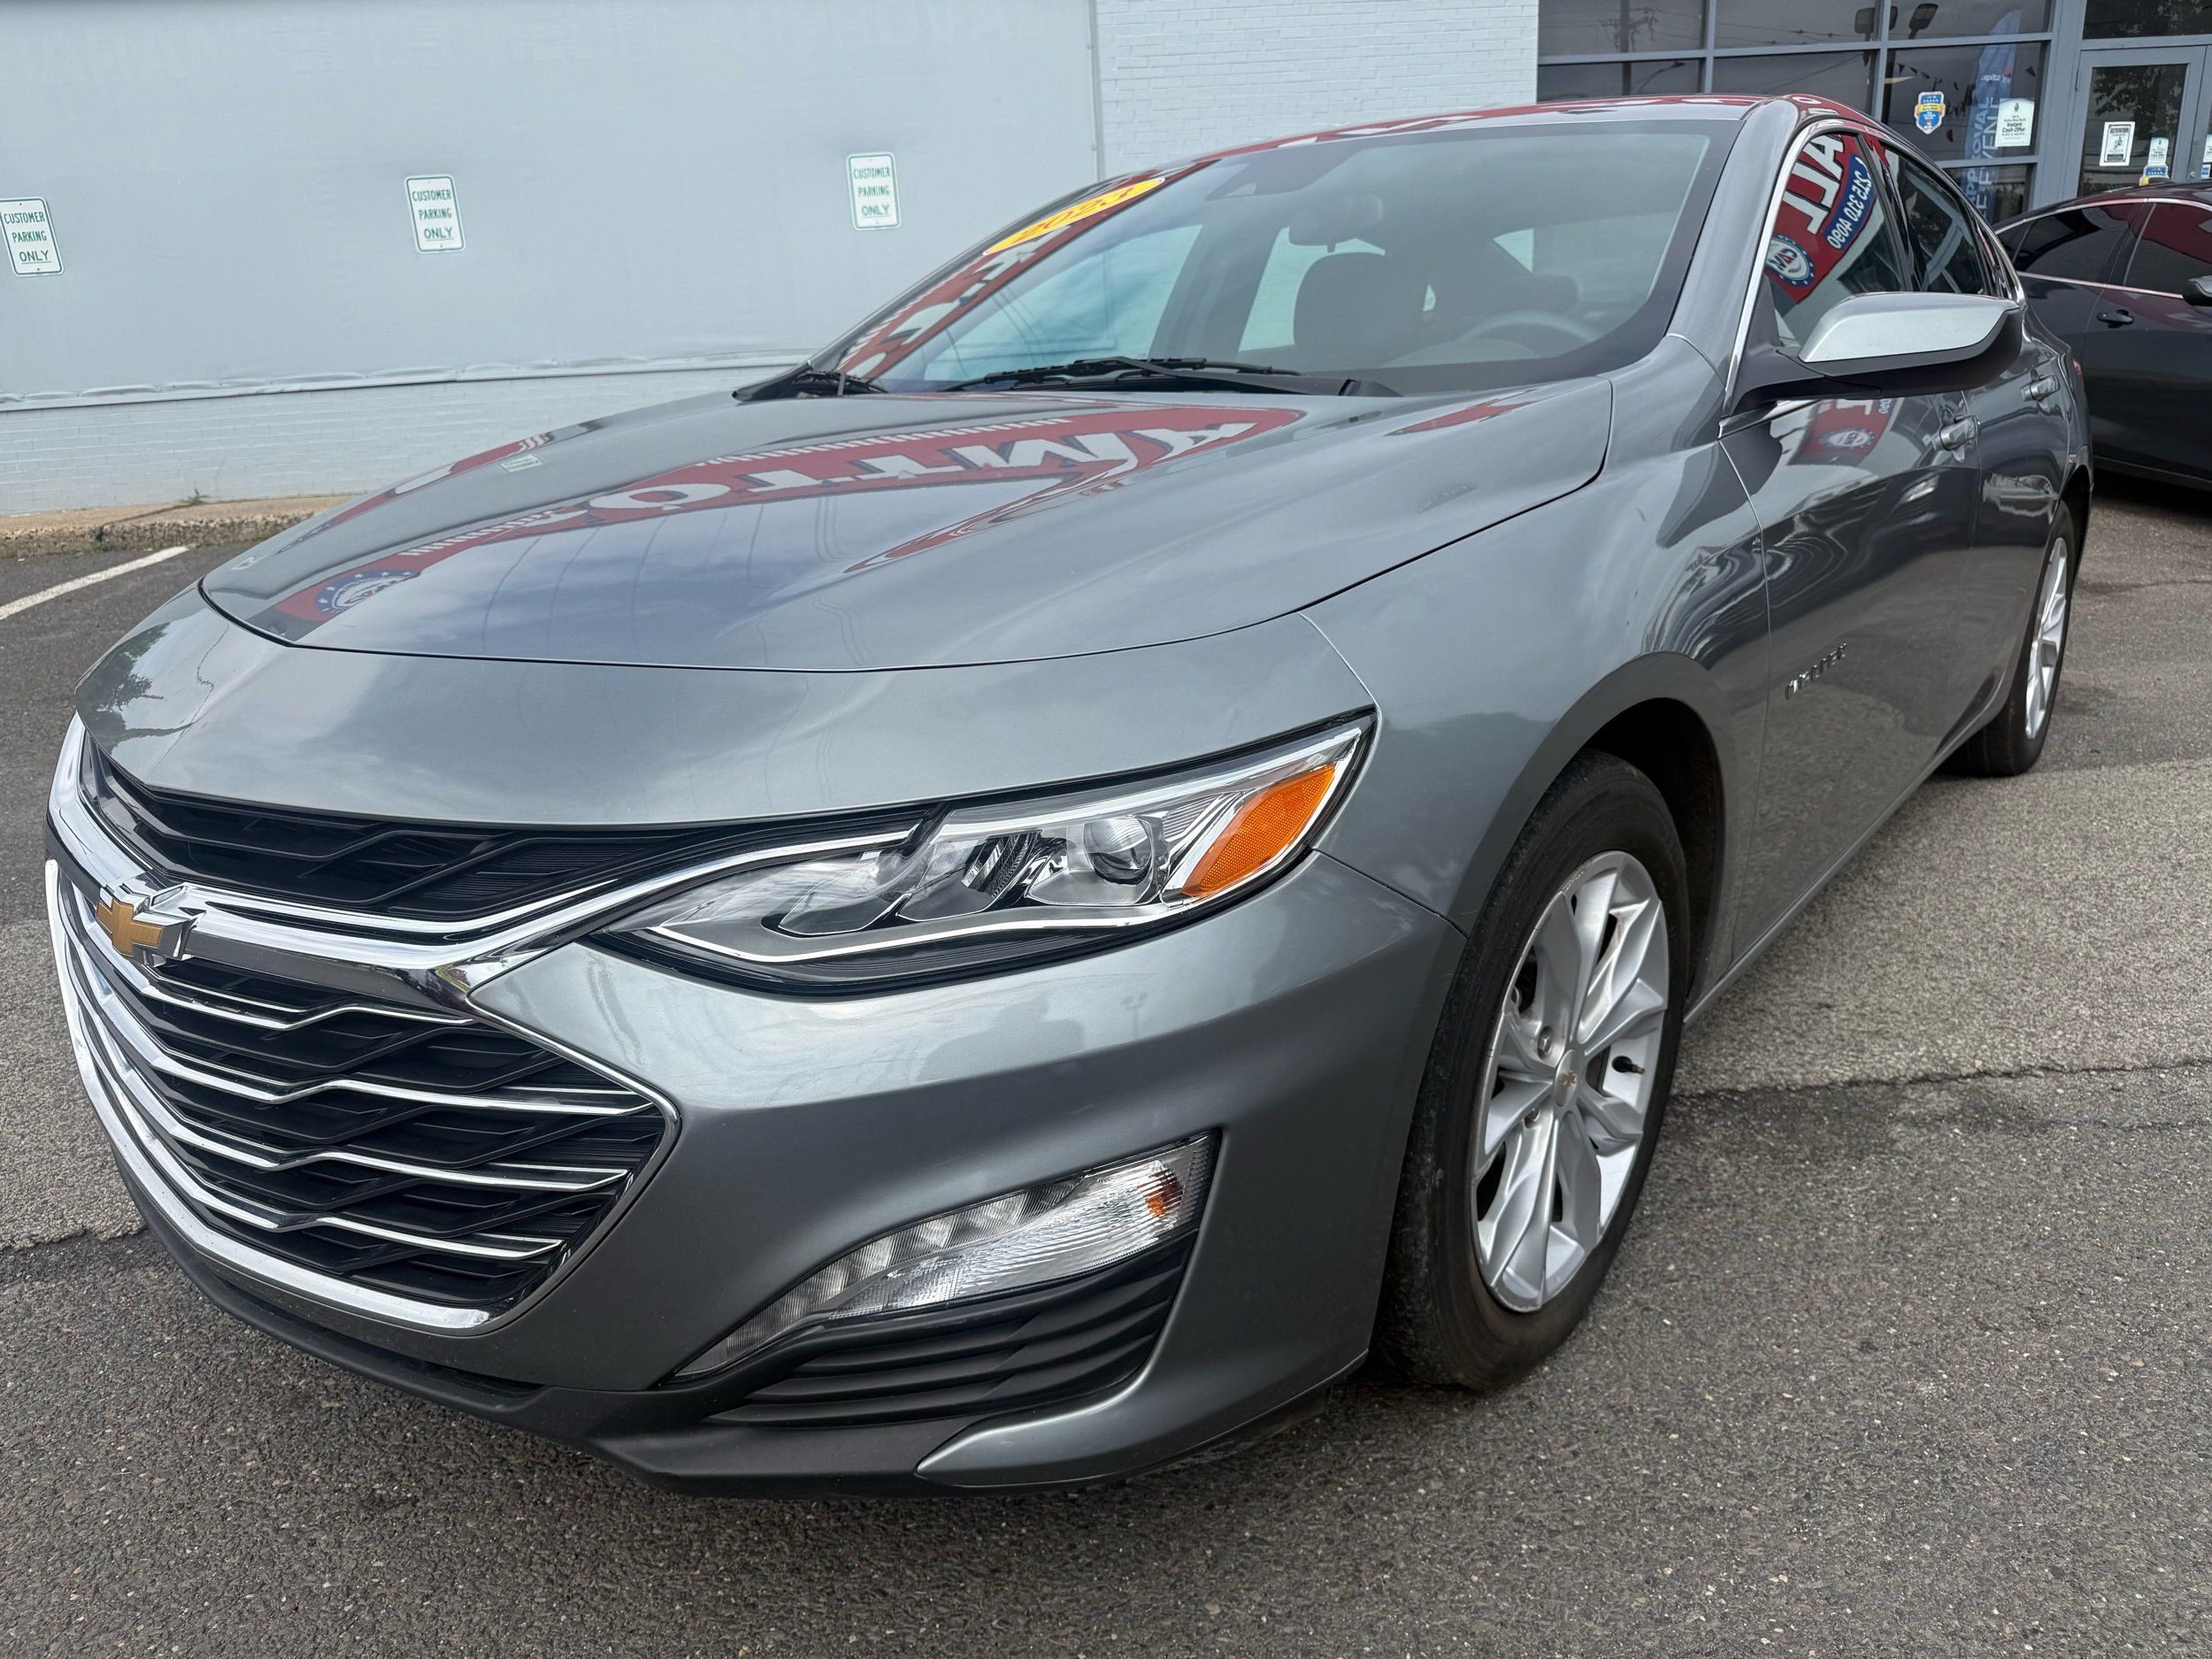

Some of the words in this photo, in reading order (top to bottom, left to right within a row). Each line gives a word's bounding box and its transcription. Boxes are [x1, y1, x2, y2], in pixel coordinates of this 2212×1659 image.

[411, 189, 452, 202] CUSTOMER
[4, 211, 46, 224] CUSTOMER
[419, 208, 452, 219] PARKING
[12, 230, 47, 242] PARKING
[424, 227, 452, 239] ONLY
[19, 250, 49, 262] ONLY
